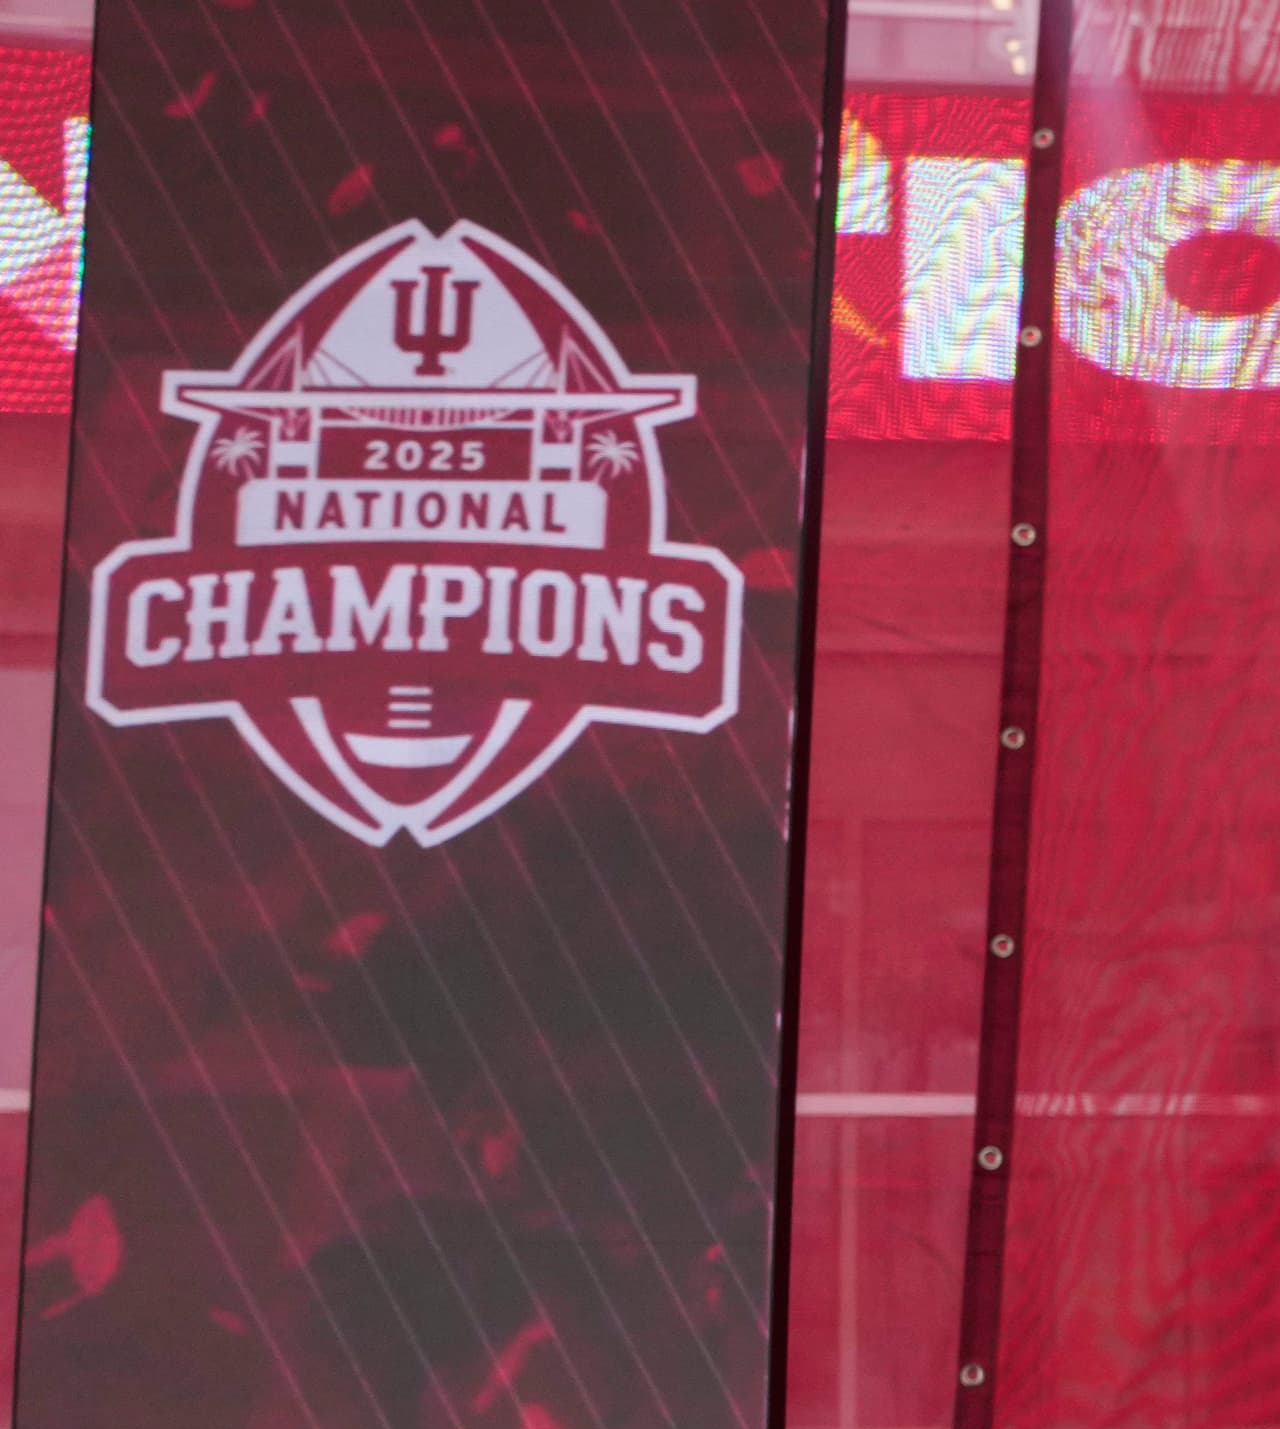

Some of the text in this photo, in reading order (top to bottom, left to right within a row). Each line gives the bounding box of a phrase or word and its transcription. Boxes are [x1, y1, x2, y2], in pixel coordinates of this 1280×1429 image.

[364, 440, 485, 471] 2025
[275, 490, 567, 534] NATIONAL
[125, 564, 704, 673] CHAMPIONS
